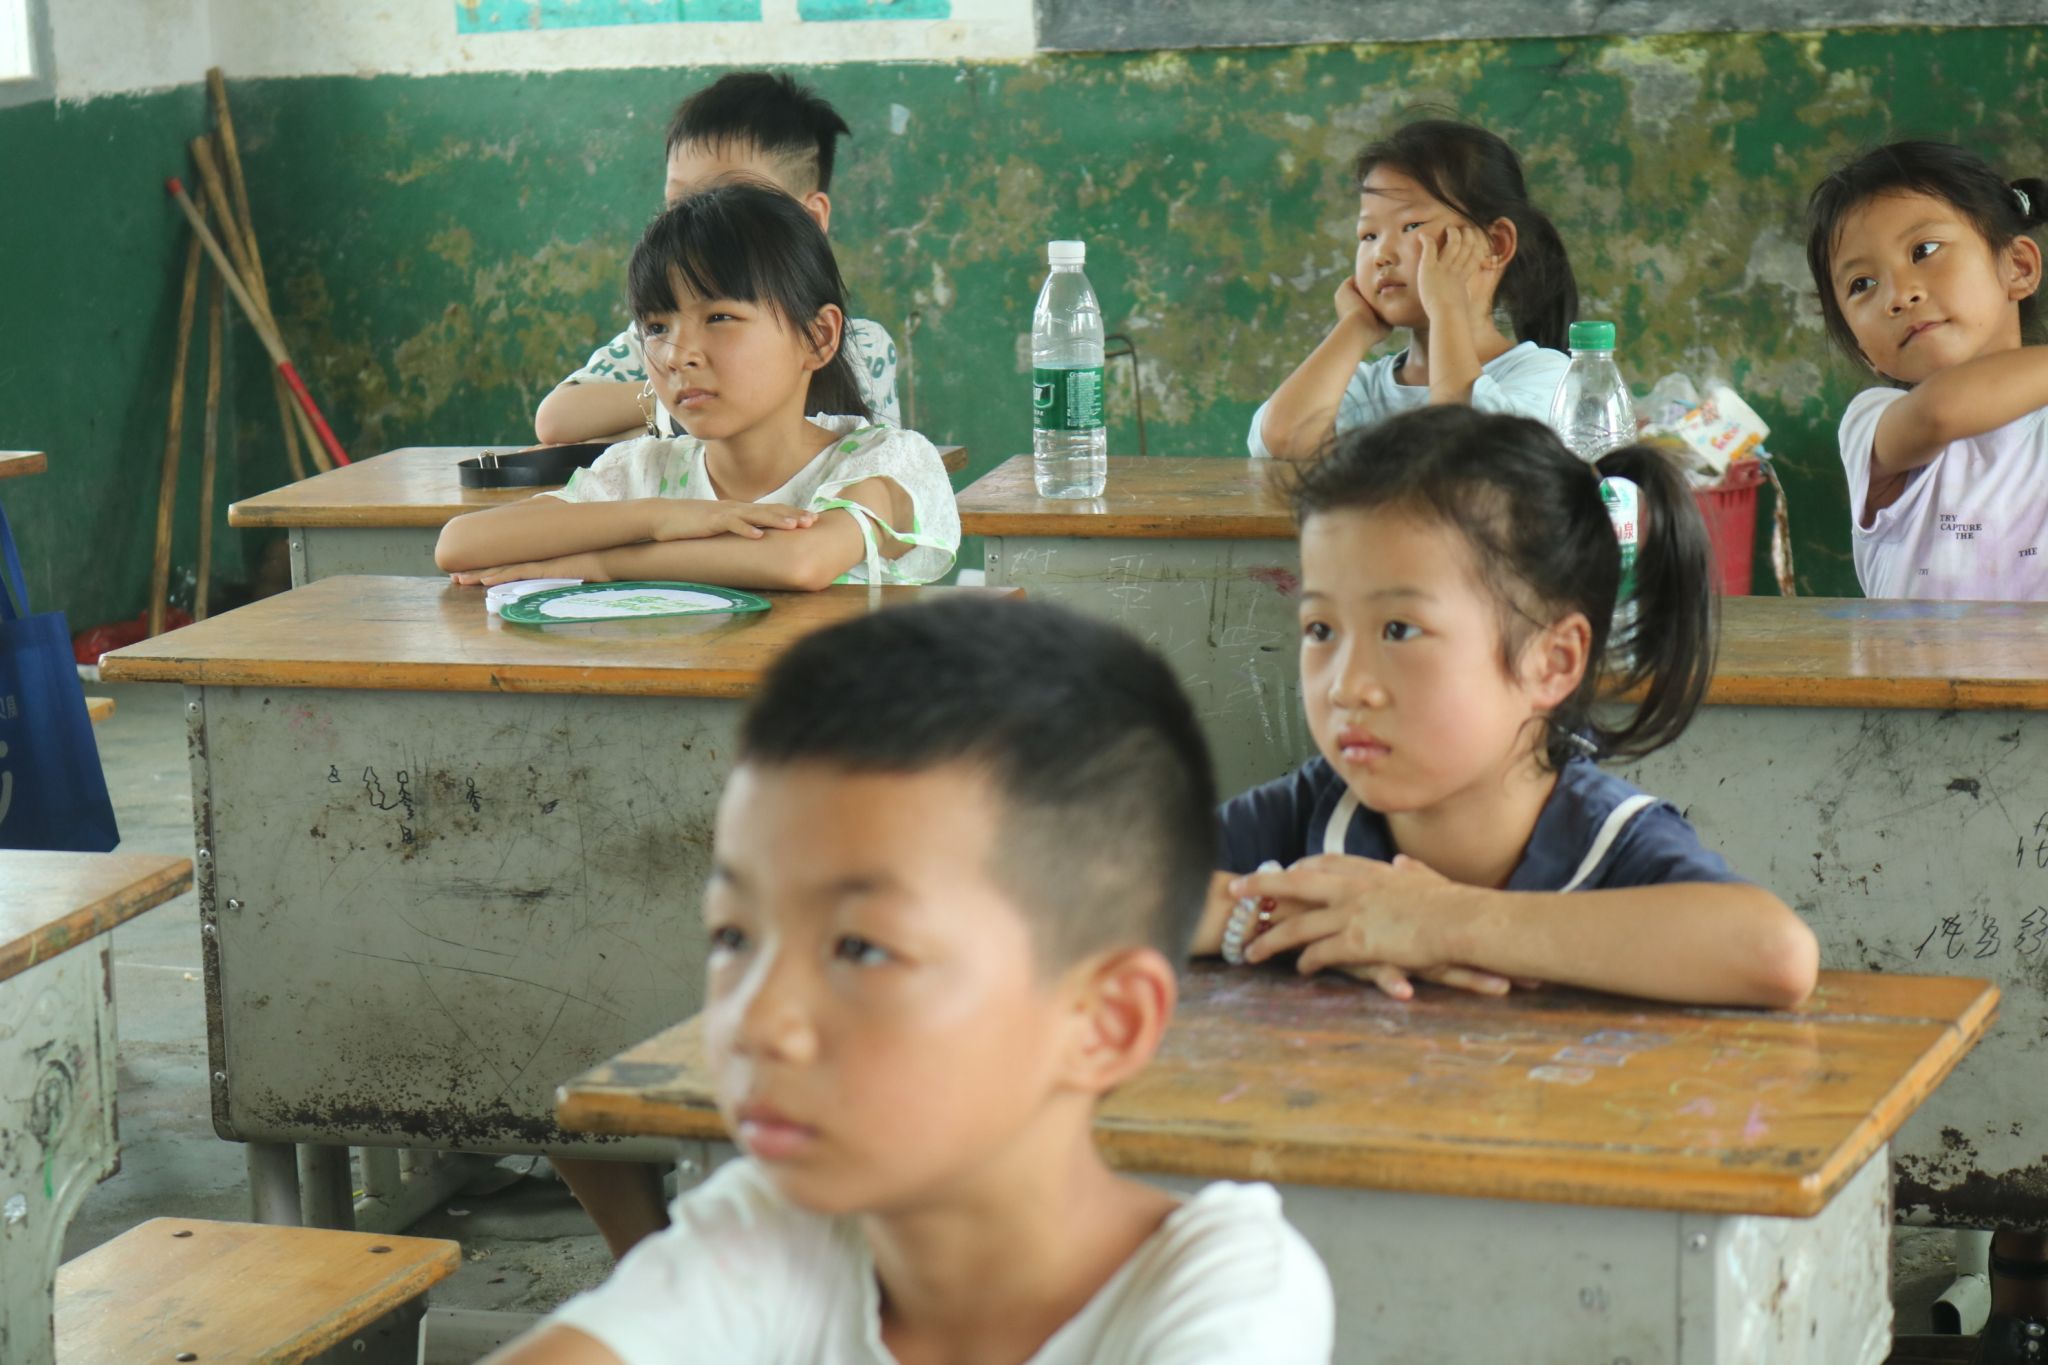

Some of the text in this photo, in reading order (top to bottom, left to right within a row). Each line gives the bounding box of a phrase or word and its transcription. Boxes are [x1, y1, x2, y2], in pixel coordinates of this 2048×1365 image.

[1940, 514, 1958, 522] TRY
[1940, 523, 1982, 532] CAPTURE
[1955, 532, 1974, 540] THE
[2018, 547, 2038, 558] THE
